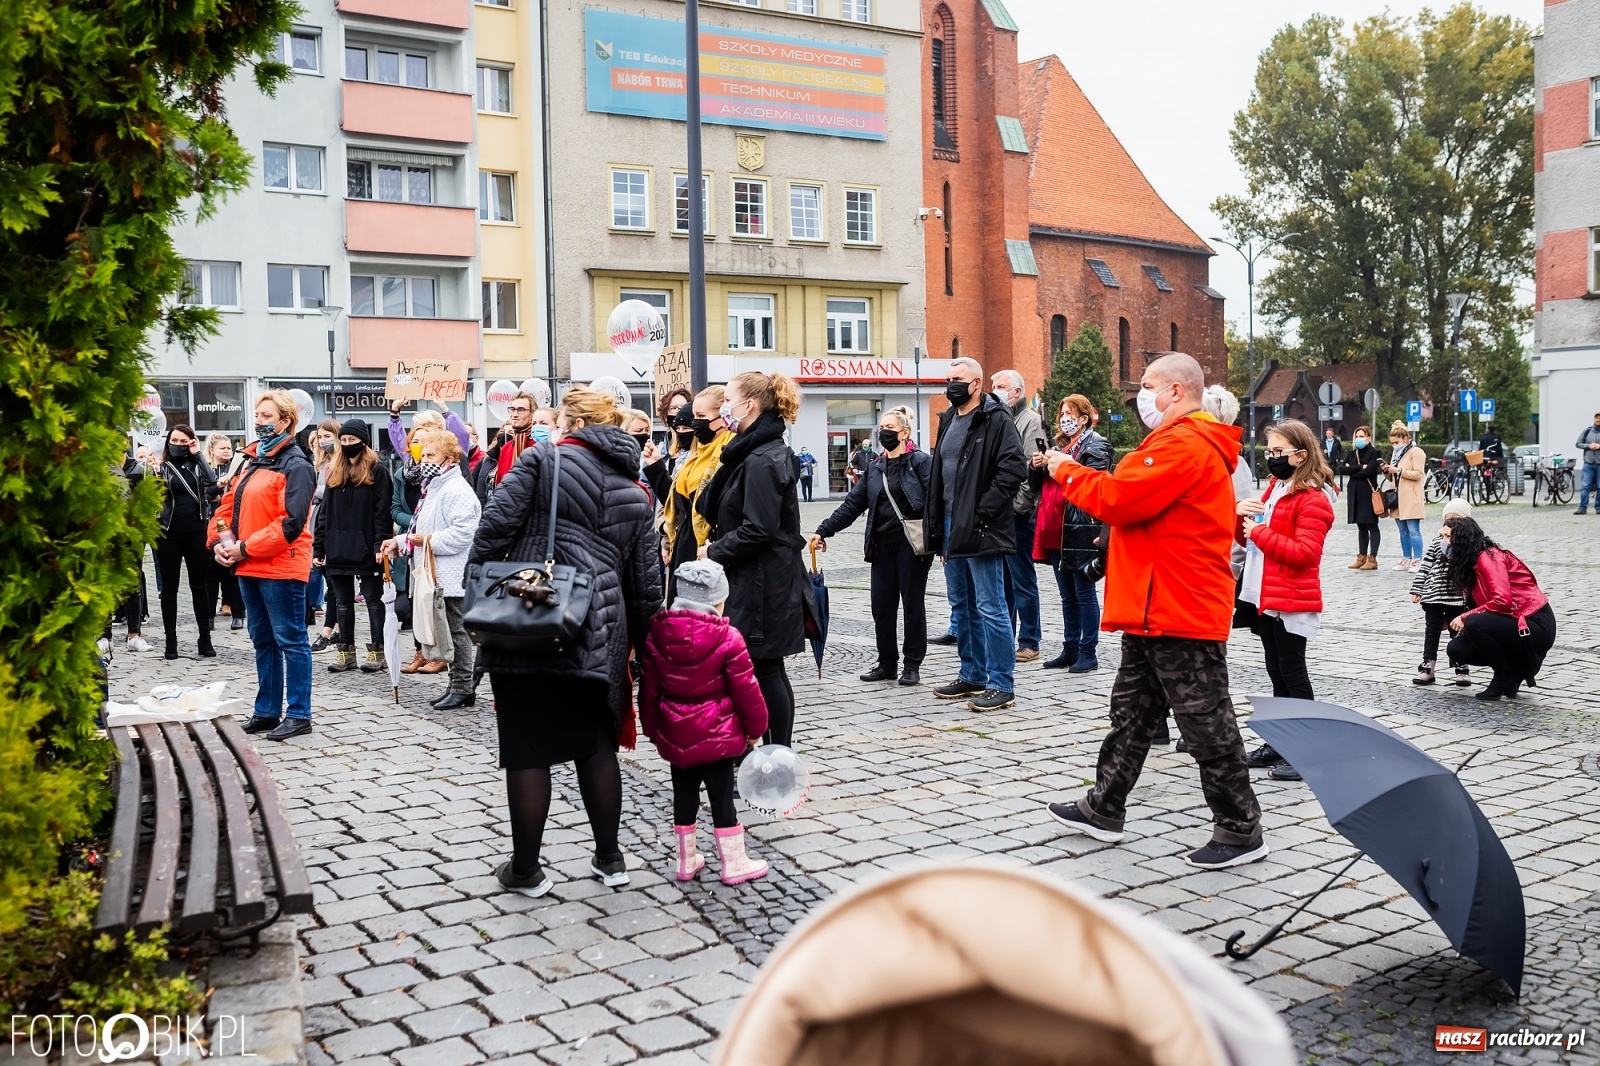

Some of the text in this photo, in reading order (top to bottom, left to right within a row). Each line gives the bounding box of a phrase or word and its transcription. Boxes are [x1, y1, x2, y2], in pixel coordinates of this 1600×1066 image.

[618, 50, 686, 68] TEB Edukacj
[719, 41, 863, 68] SZKOŁY MEDYCZNE
[617, 72, 684, 89] NABÓR TRWA
[719, 61, 871, 89] SZKOŁY POLICEALNE
[720, 82, 811, 102] TECHNIKUM
[720, 104, 866, 128] AKADEMIA III WIEKU
[396, 361, 420, 374] Don't
[800, 358, 904, 376] ROSSMANN
[196, 401, 241, 412] empik.com
[1410, 403, 1419, 416] P
[1482, 401, 1492, 412] P
